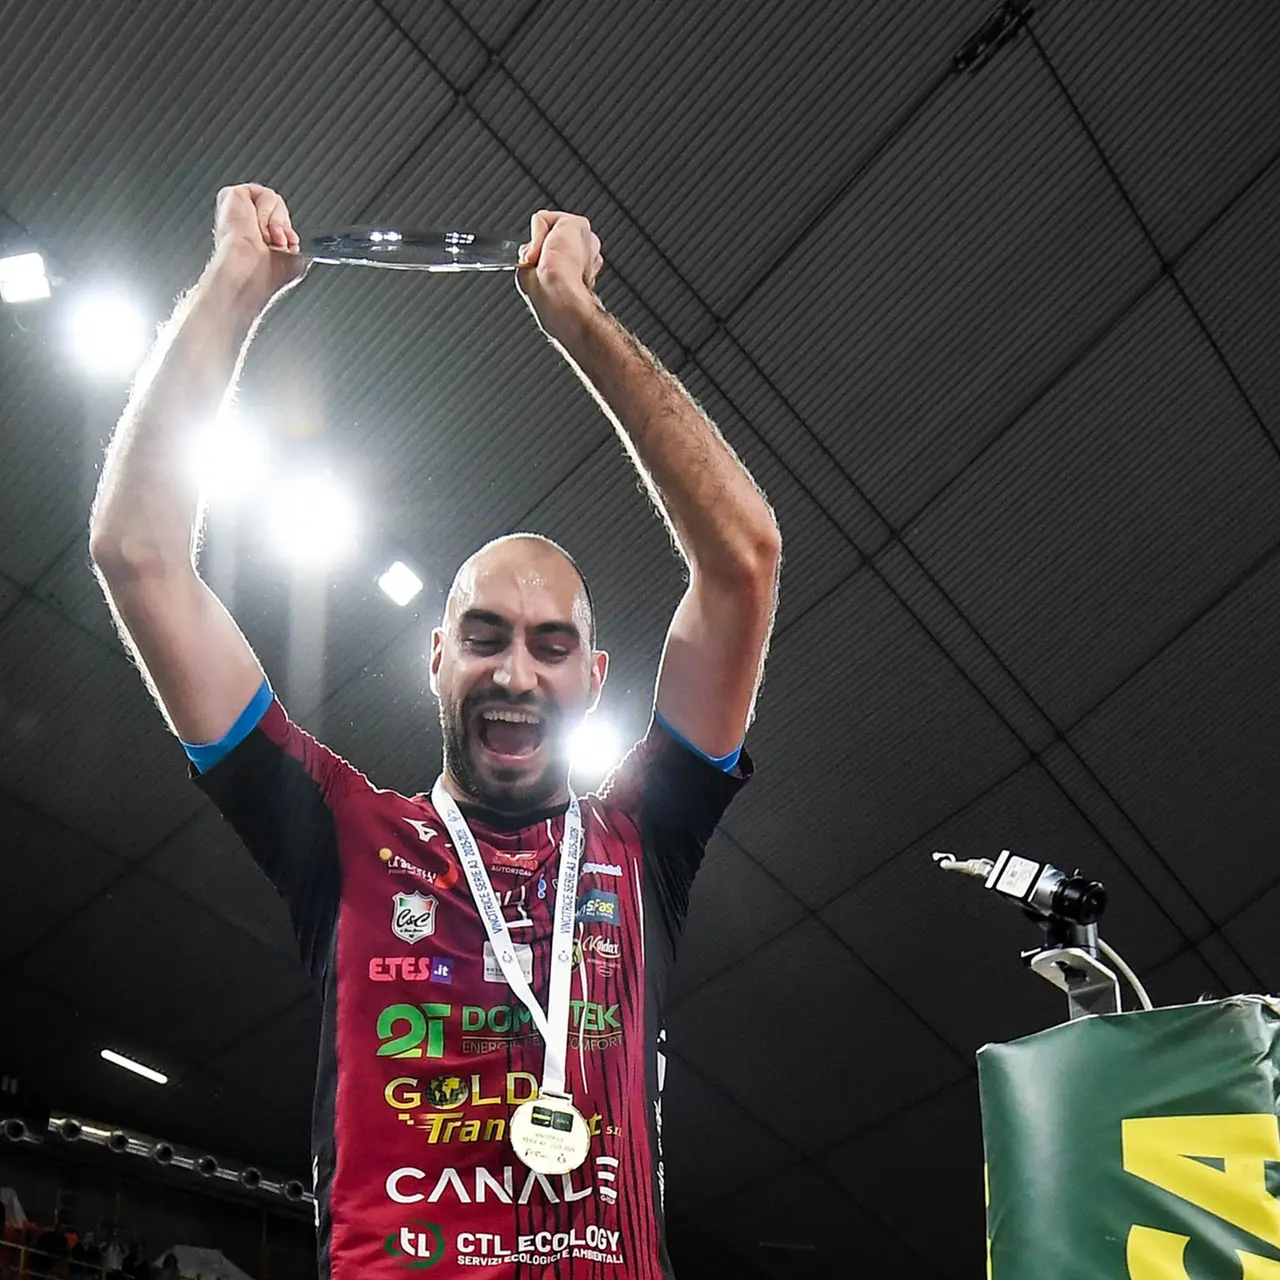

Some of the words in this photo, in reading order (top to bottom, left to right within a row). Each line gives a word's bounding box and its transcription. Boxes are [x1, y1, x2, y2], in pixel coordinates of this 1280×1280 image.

[461, 999, 622, 1034] DOMTEK
[385, 1156, 619, 1205] CANALE
[456, 1232, 512, 1256] CTL
[517, 1225, 621, 1253] ECOLOGY
[457, 1254, 504, 1267] SERVIZI
[504, 1251, 561, 1266] ECOLOGICI
